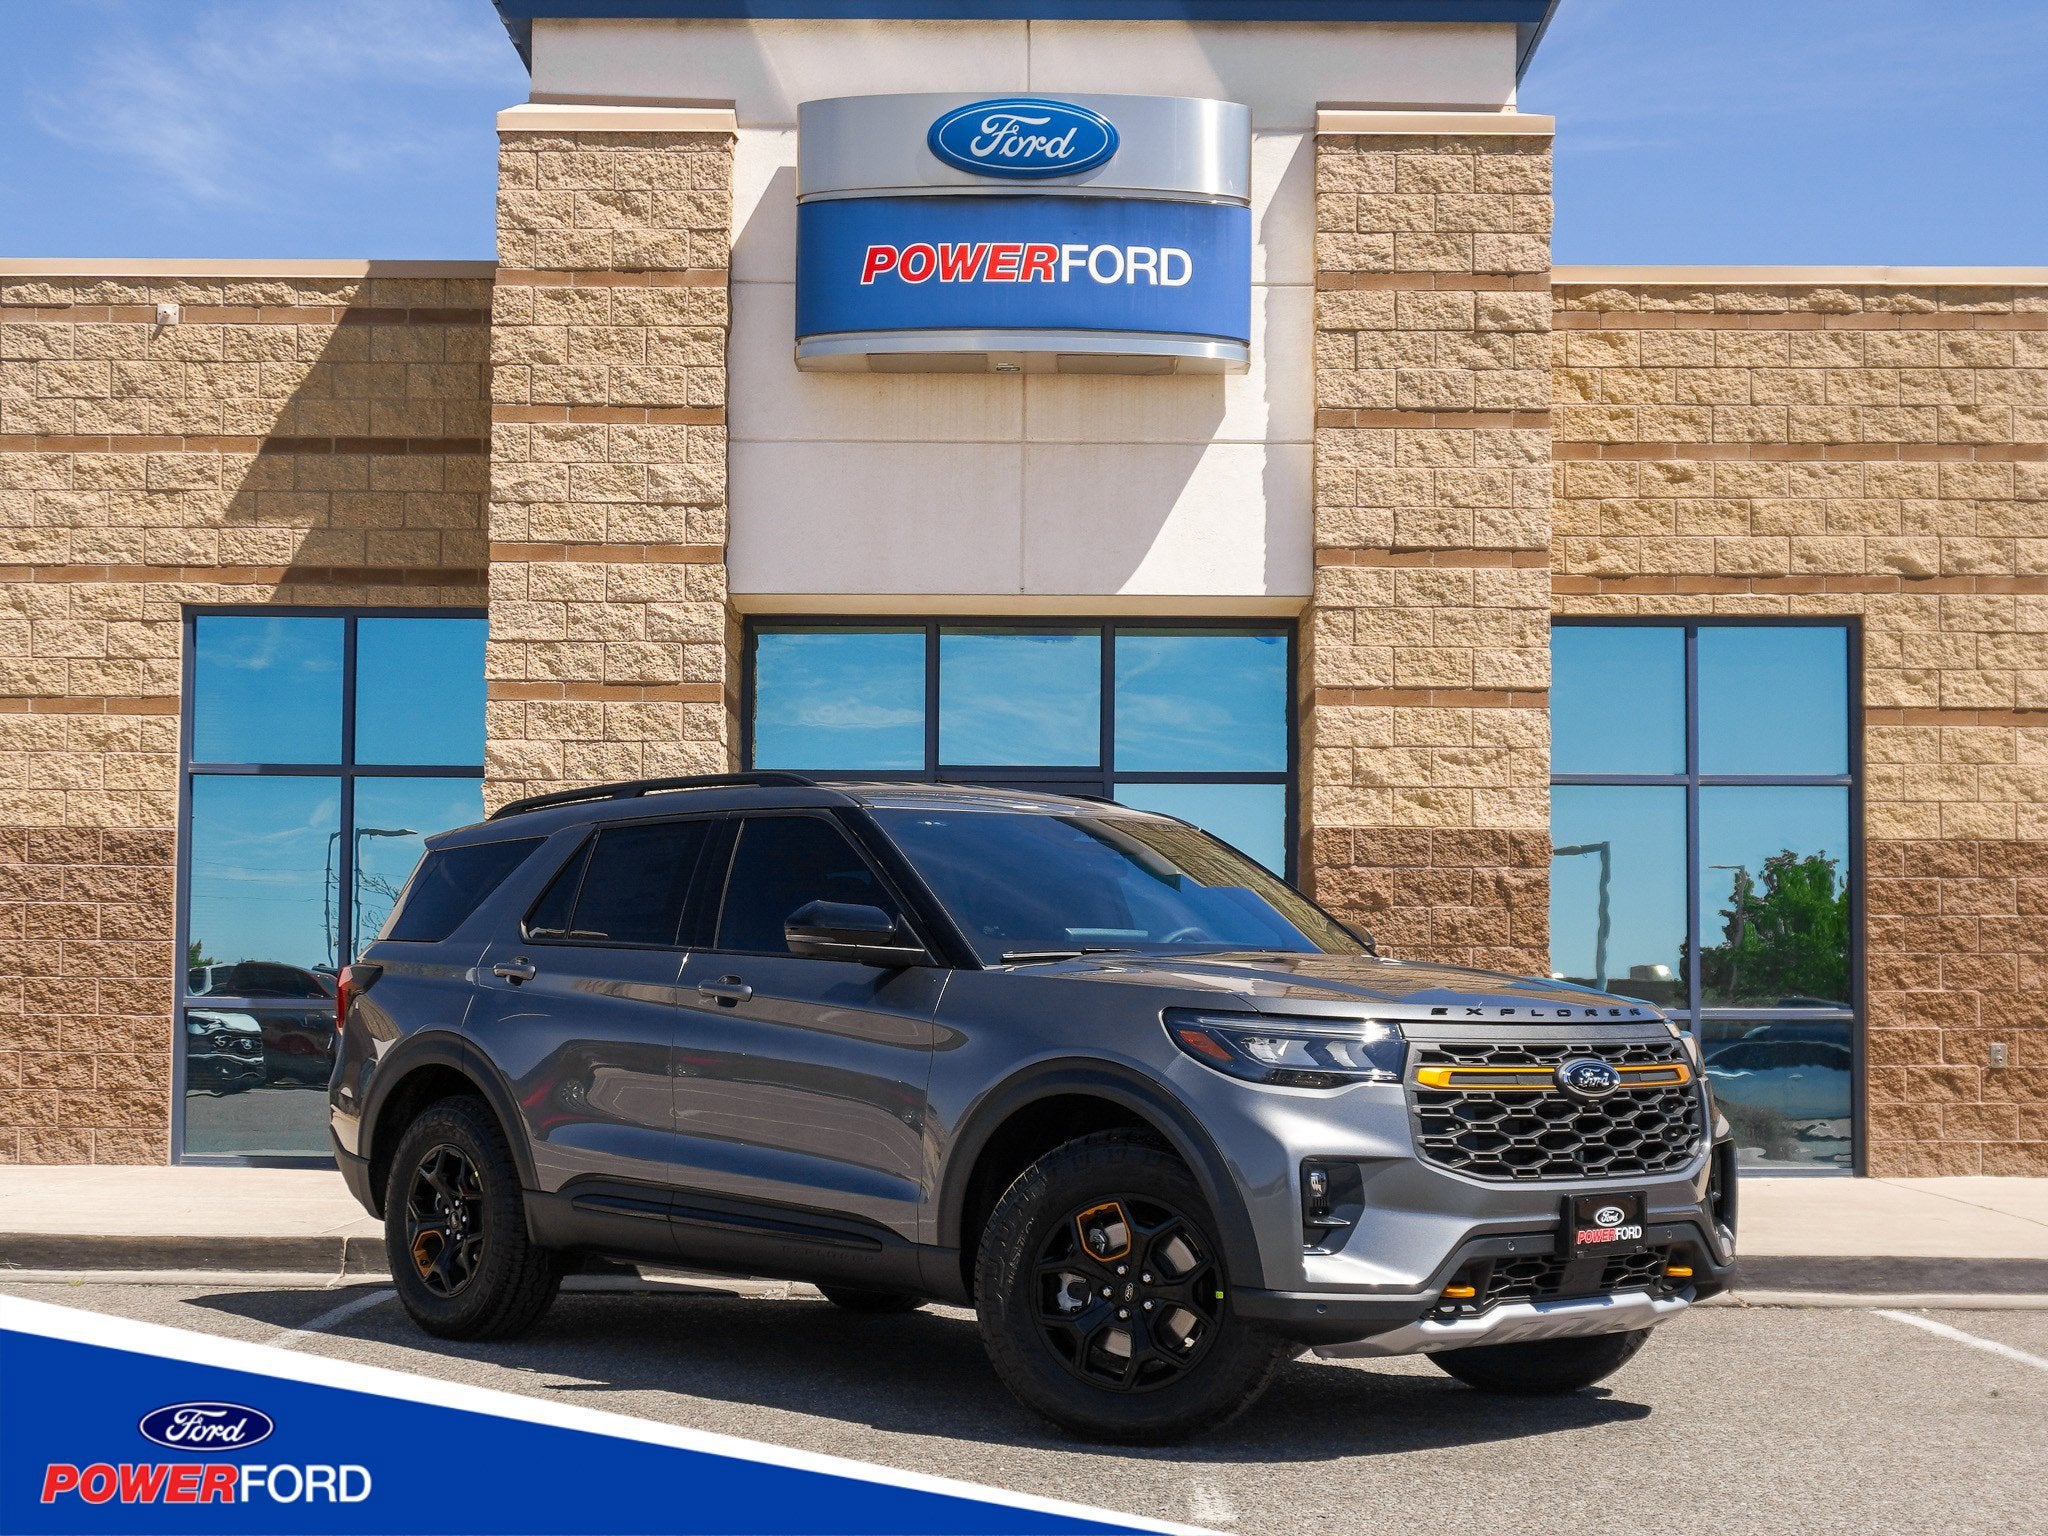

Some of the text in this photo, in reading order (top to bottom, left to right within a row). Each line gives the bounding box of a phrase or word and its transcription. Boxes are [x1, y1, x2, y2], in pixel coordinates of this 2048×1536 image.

[970, 113, 1077, 160] Ford
[860, 242, 1193, 287] POWERFORD
[1430, 1006, 1642, 1018] EXPLORER
[1579, 1067, 1610, 1088] Ford
[1601, 1210, 1619, 1222] Ford
[1577, 1225, 1642, 1244] POWERFORD
